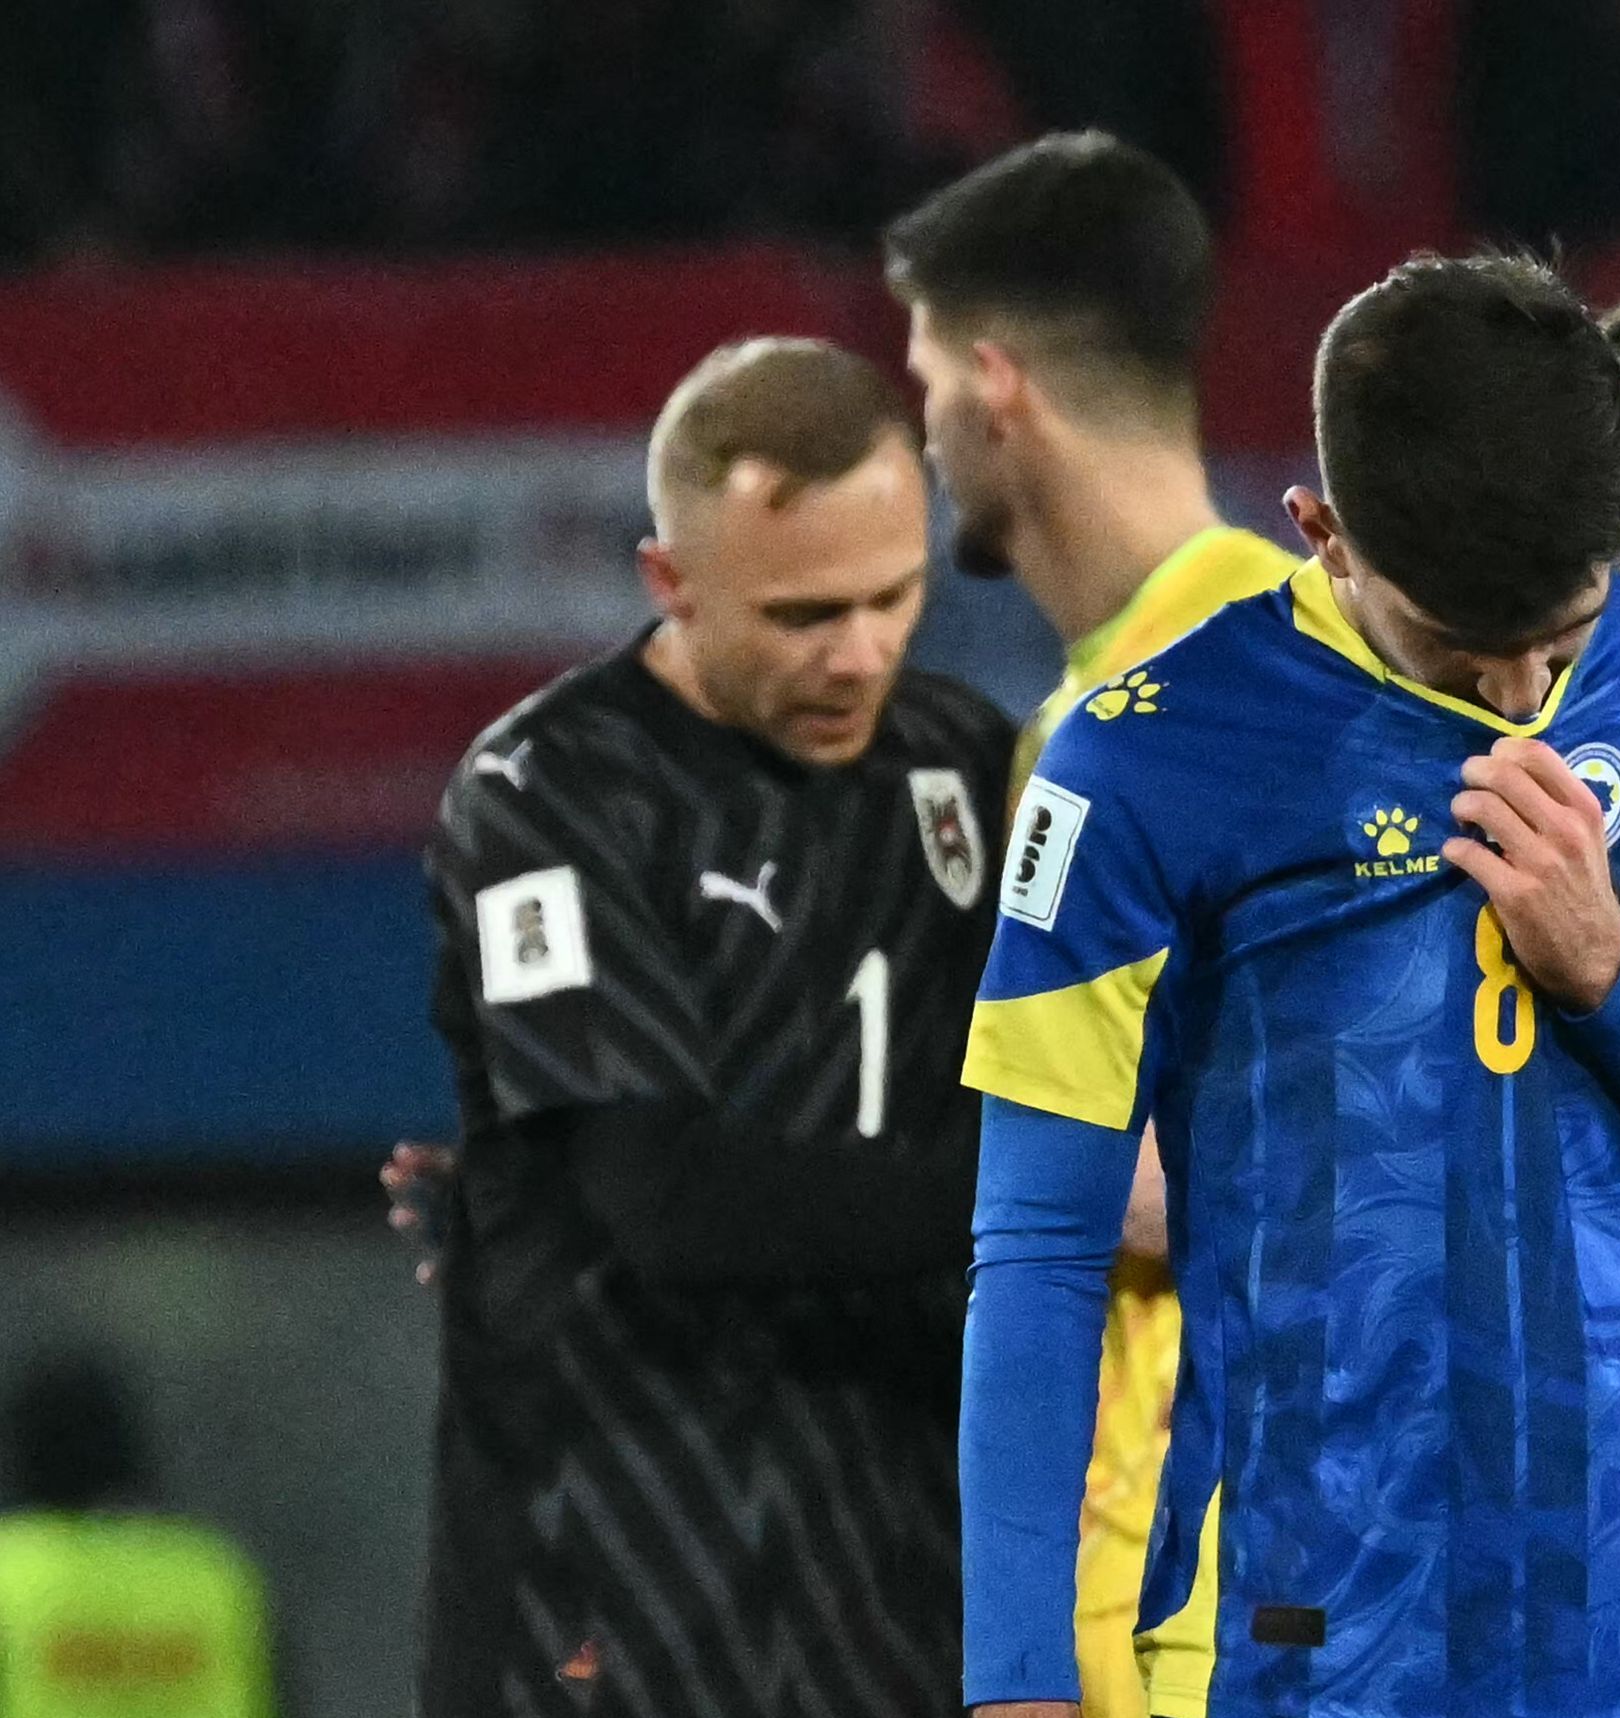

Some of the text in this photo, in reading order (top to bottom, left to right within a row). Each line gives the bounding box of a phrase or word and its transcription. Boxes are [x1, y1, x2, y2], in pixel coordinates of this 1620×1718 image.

[1354, 855, 1440, 878] KELME
[846, 948, 888, 1138] 1
[1474, 902, 1536, 1074] 8
